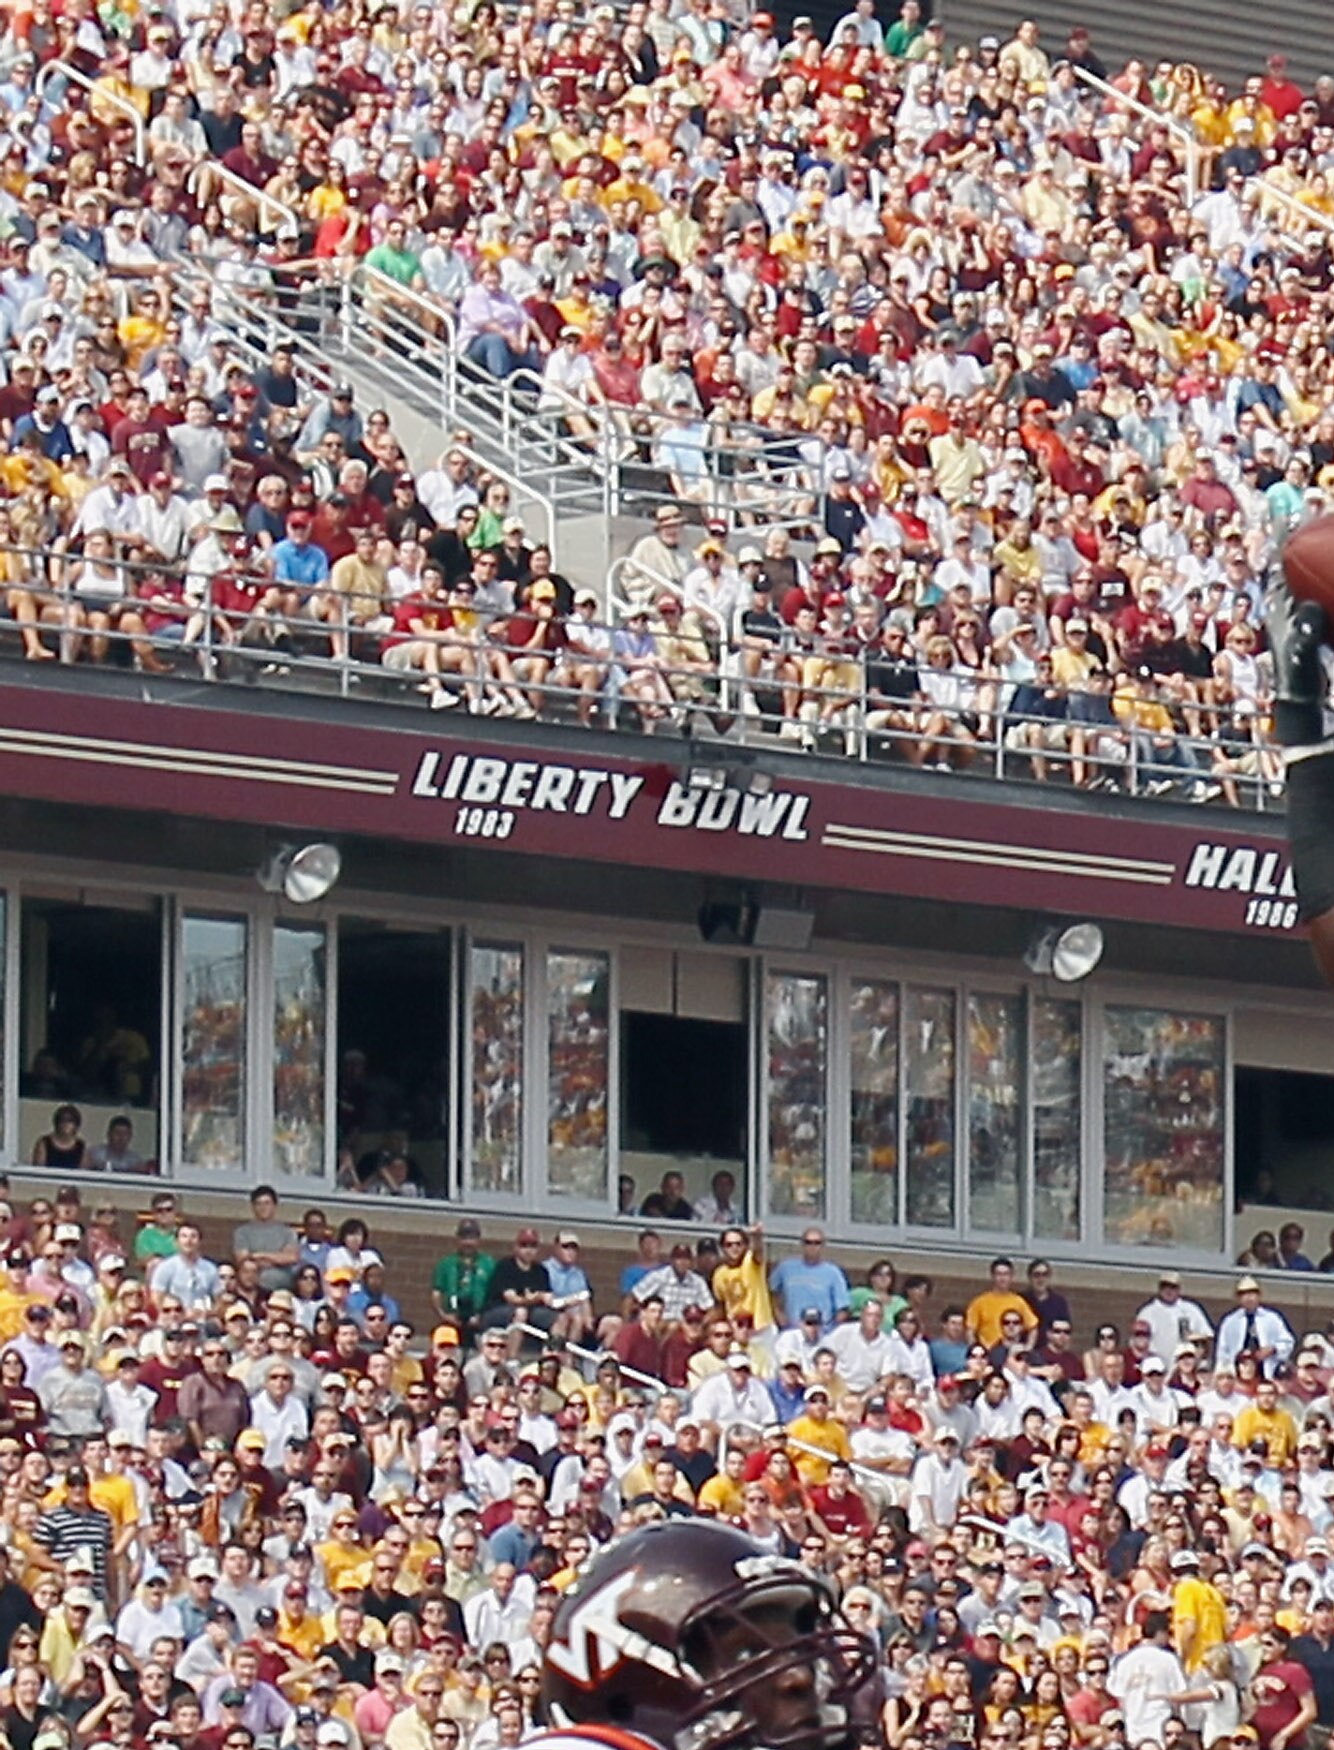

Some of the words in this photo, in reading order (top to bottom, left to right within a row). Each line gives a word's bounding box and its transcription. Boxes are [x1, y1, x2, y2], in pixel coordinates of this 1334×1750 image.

[412, 751, 643, 819] LIBERTY
[658, 779, 810, 840] BOWL
[455, 806, 515, 839] 1983
[1245, 900, 1299, 929] 1986
